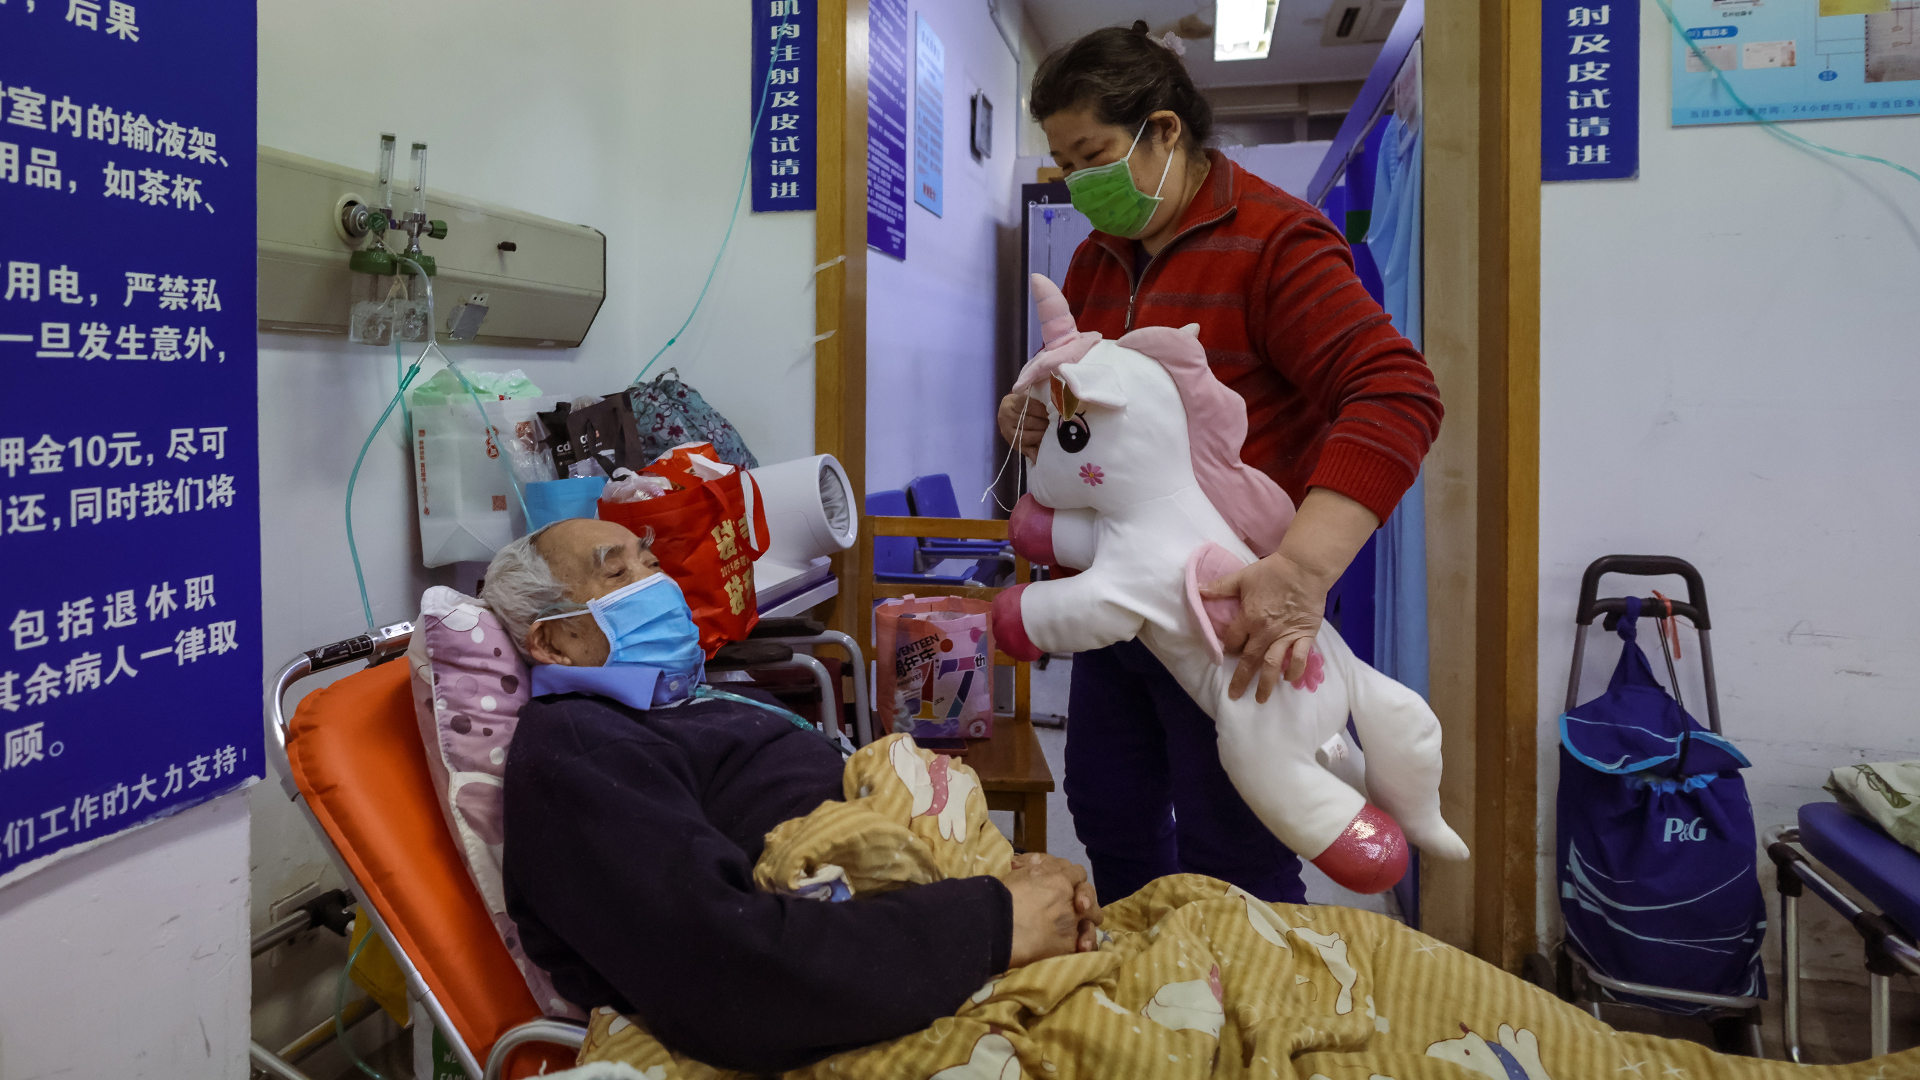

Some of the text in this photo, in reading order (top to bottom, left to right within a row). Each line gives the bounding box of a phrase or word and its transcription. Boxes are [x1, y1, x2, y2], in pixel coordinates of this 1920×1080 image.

[0, 82, 229, 168] 室内的输液架、
[770, 0, 800, 199] 肌肉注射及皮试请进
[1567, 5, 1611, 165] 射及皮试请进
[0, 474, 236, 536] 还，同时我们将
[9, 574, 216, 651] 包括退休职
[1663, 817, 1707, 842] P&G
